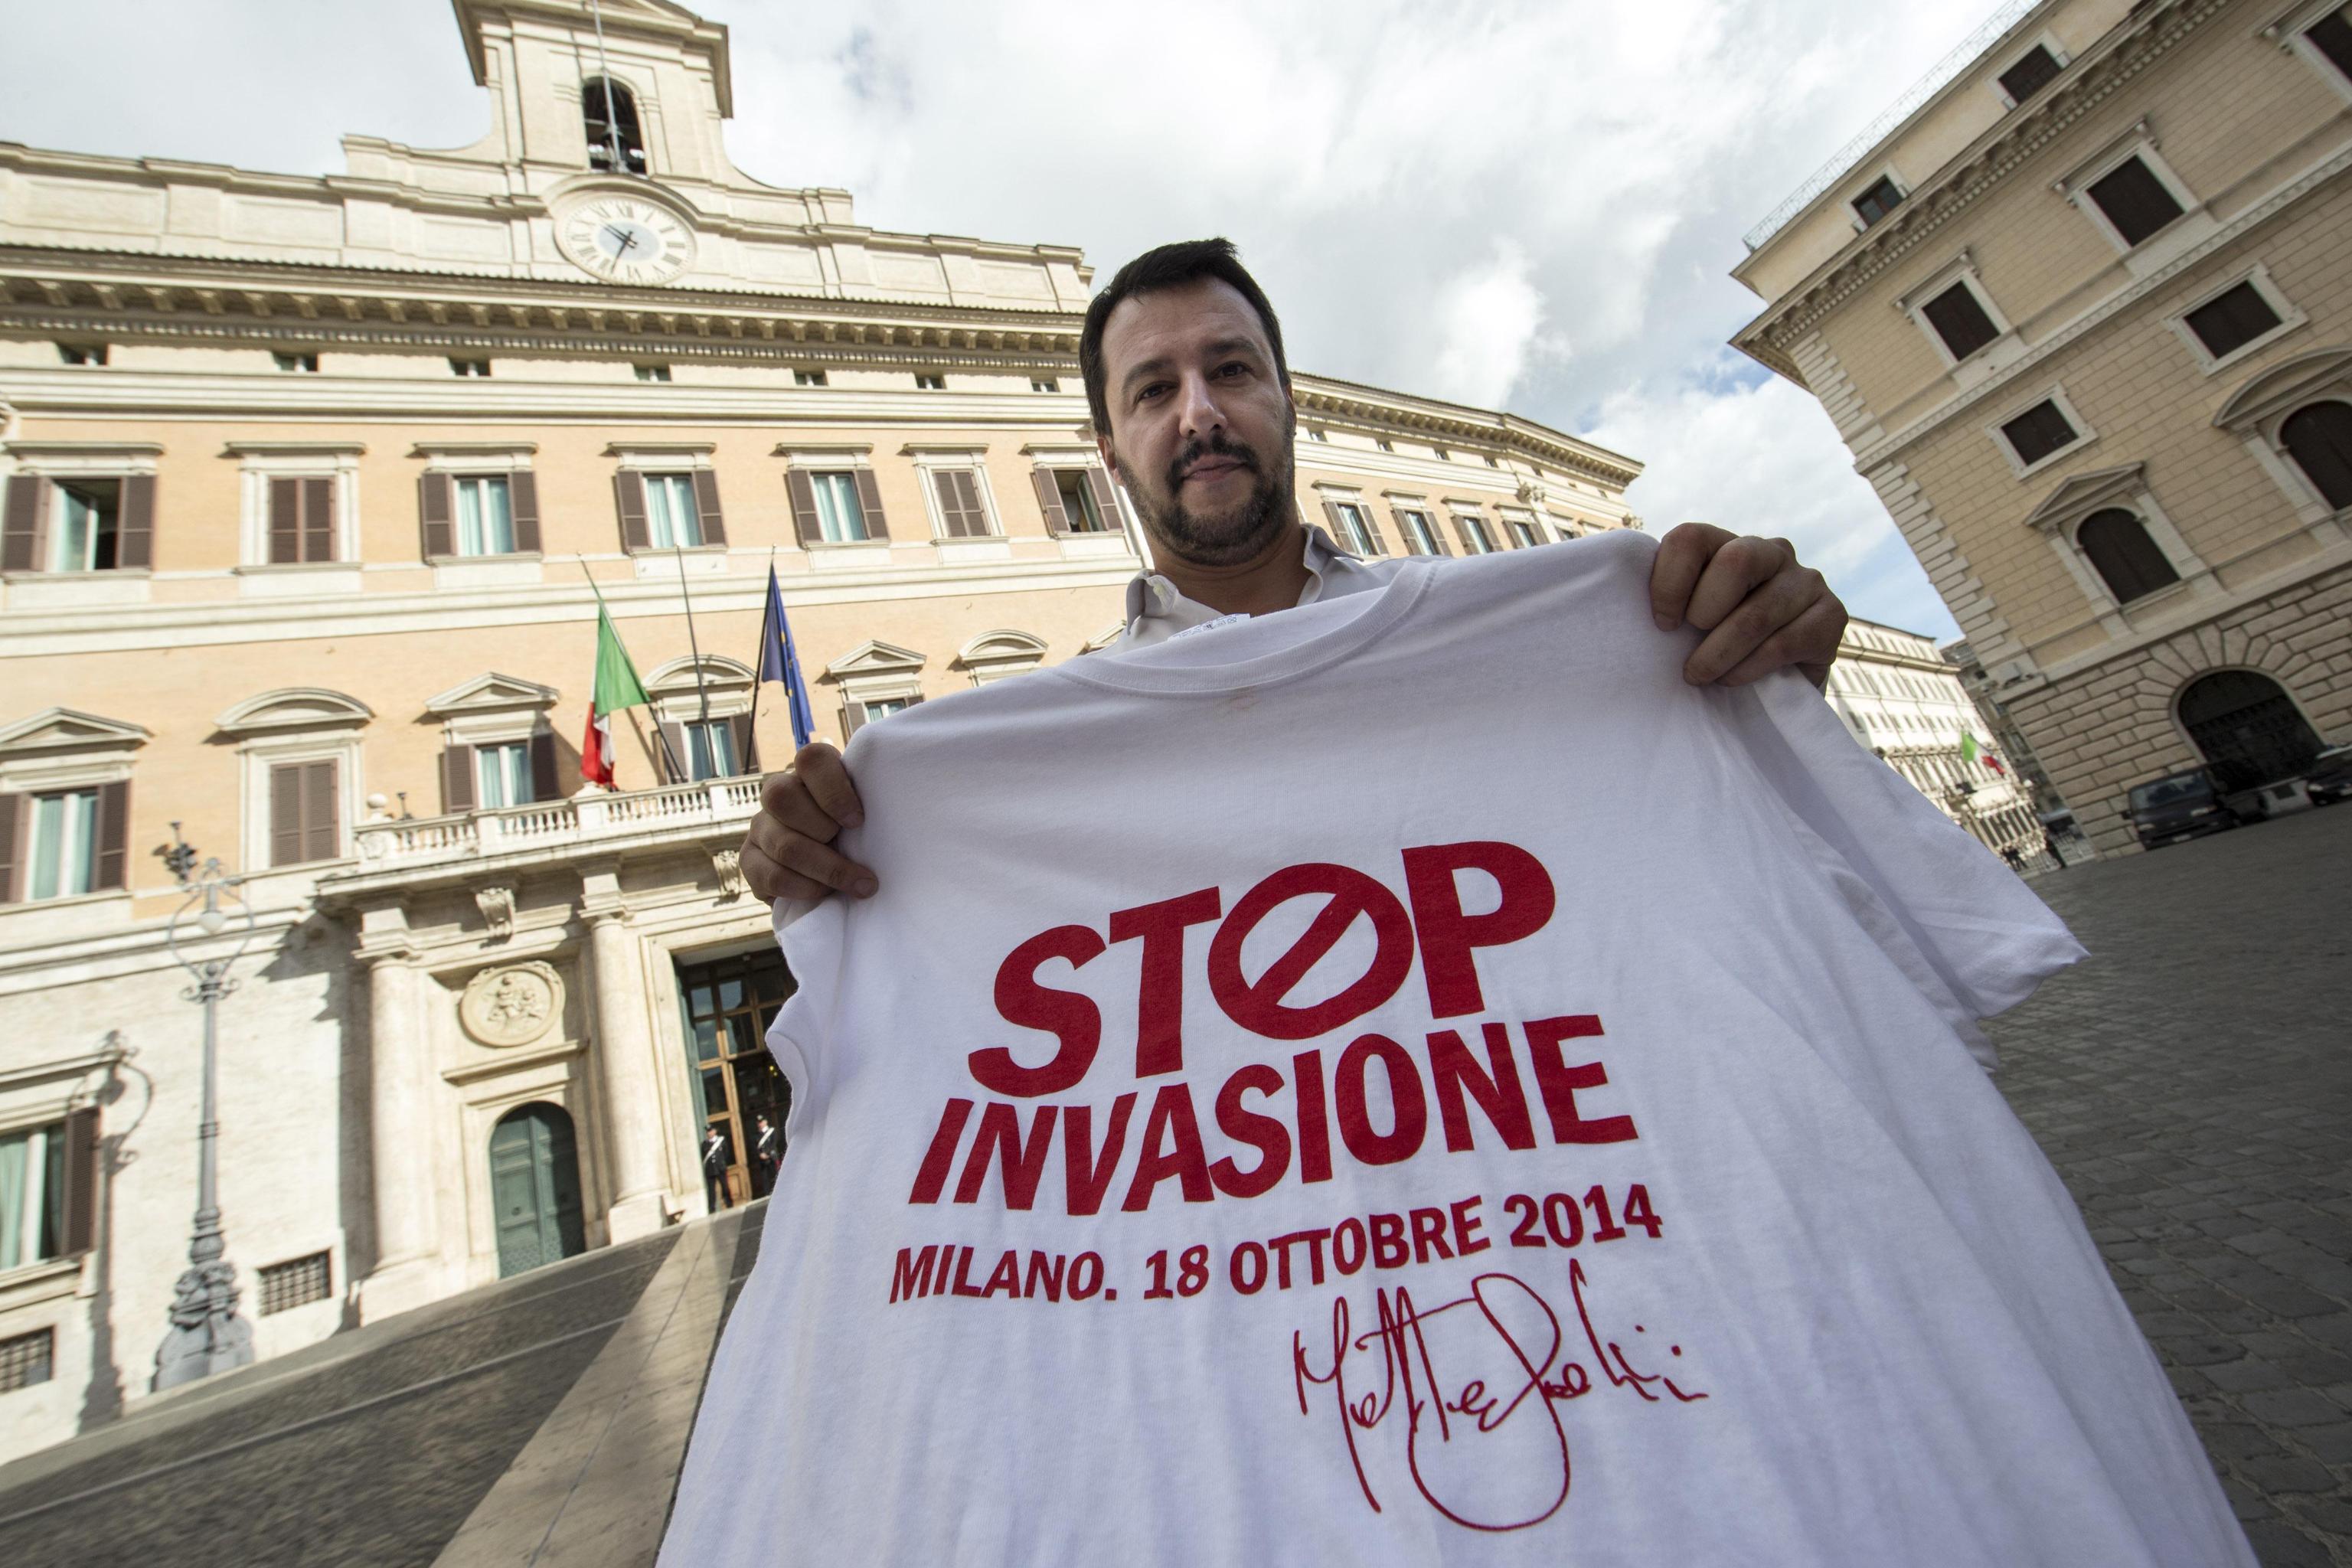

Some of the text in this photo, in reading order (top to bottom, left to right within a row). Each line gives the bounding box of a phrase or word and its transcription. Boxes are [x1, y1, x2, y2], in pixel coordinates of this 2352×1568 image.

[969, 841, 1555, 1098] STOP
[910, 1015, 1638, 1216] INVASIONE
[890, 1184, 1661, 1303] MILANO. 18 OTTOBRE 2014
